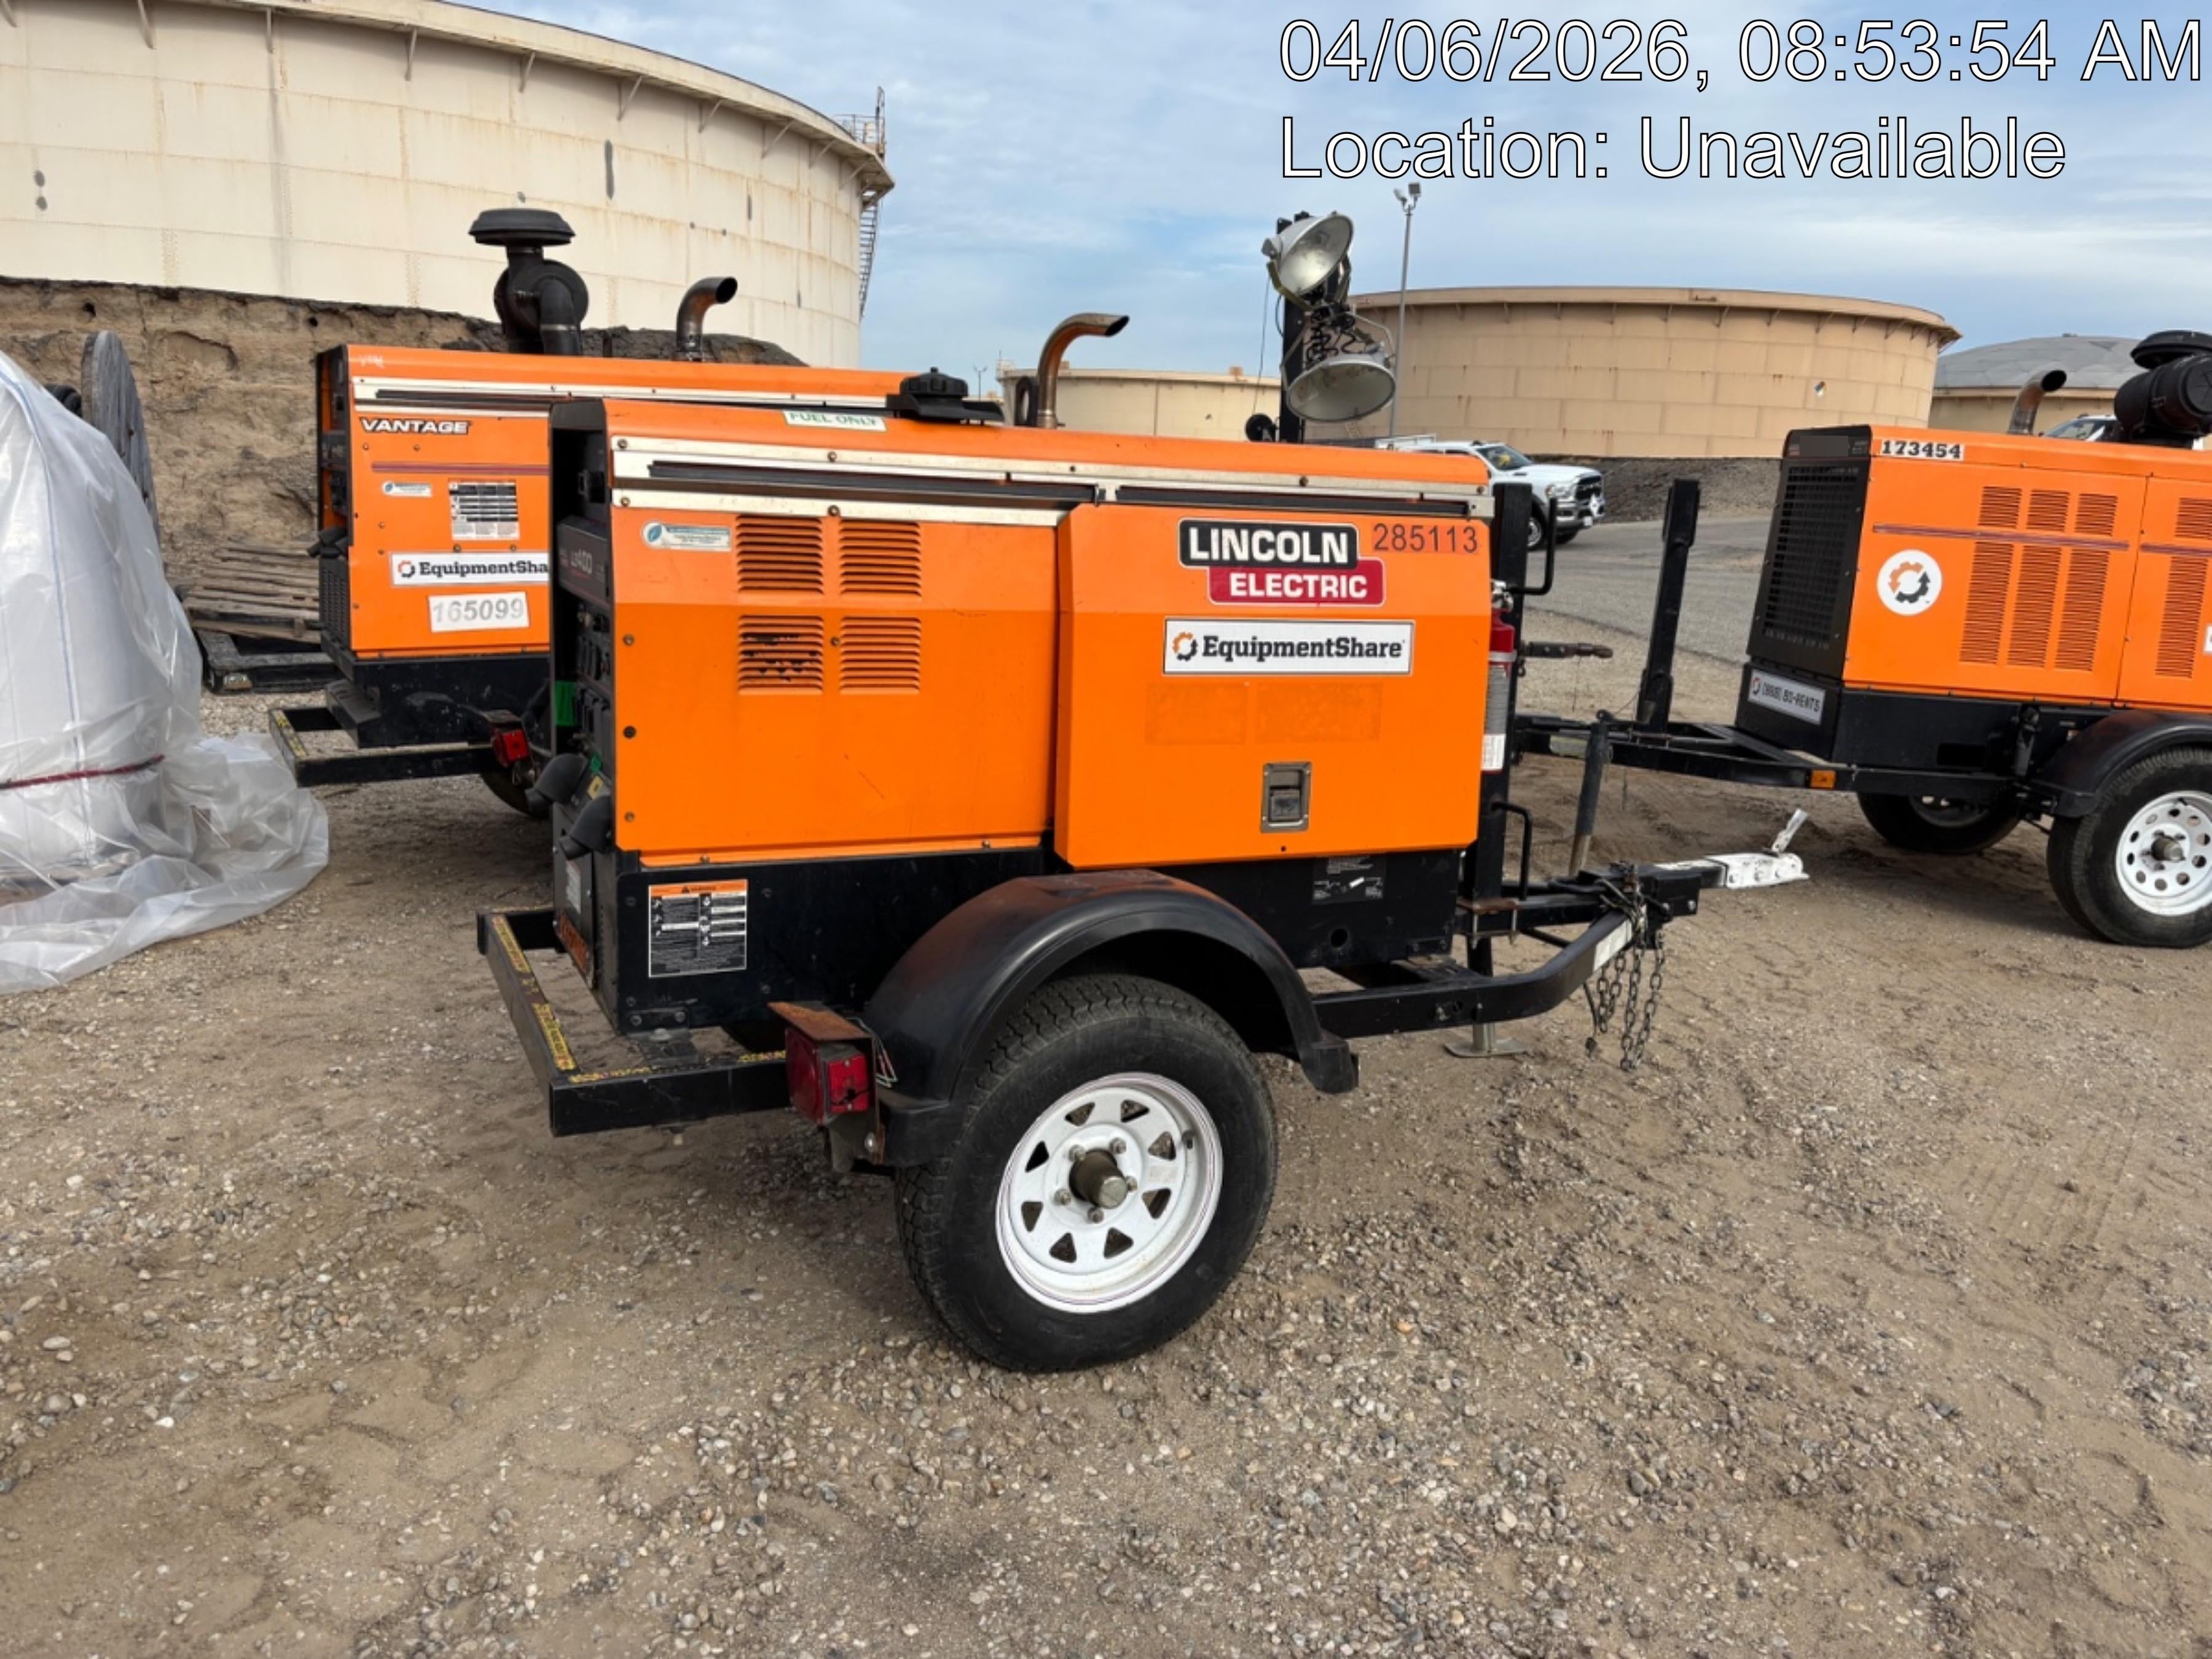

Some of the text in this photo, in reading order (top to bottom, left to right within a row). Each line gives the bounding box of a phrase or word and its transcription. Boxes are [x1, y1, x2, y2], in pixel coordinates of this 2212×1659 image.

[361, 418, 469, 434] VANTAGE
[1883, 440, 1961, 458] 173454
[1189, 527, 1348, 564] LINCOLN
[1373, 524, 1477, 552] 285113
[1230, 573, 1367, 598] ELECTRIC
[432, 598, 525, 622] 165099
[1202, 635, 1402, 662] EquipmentShare
